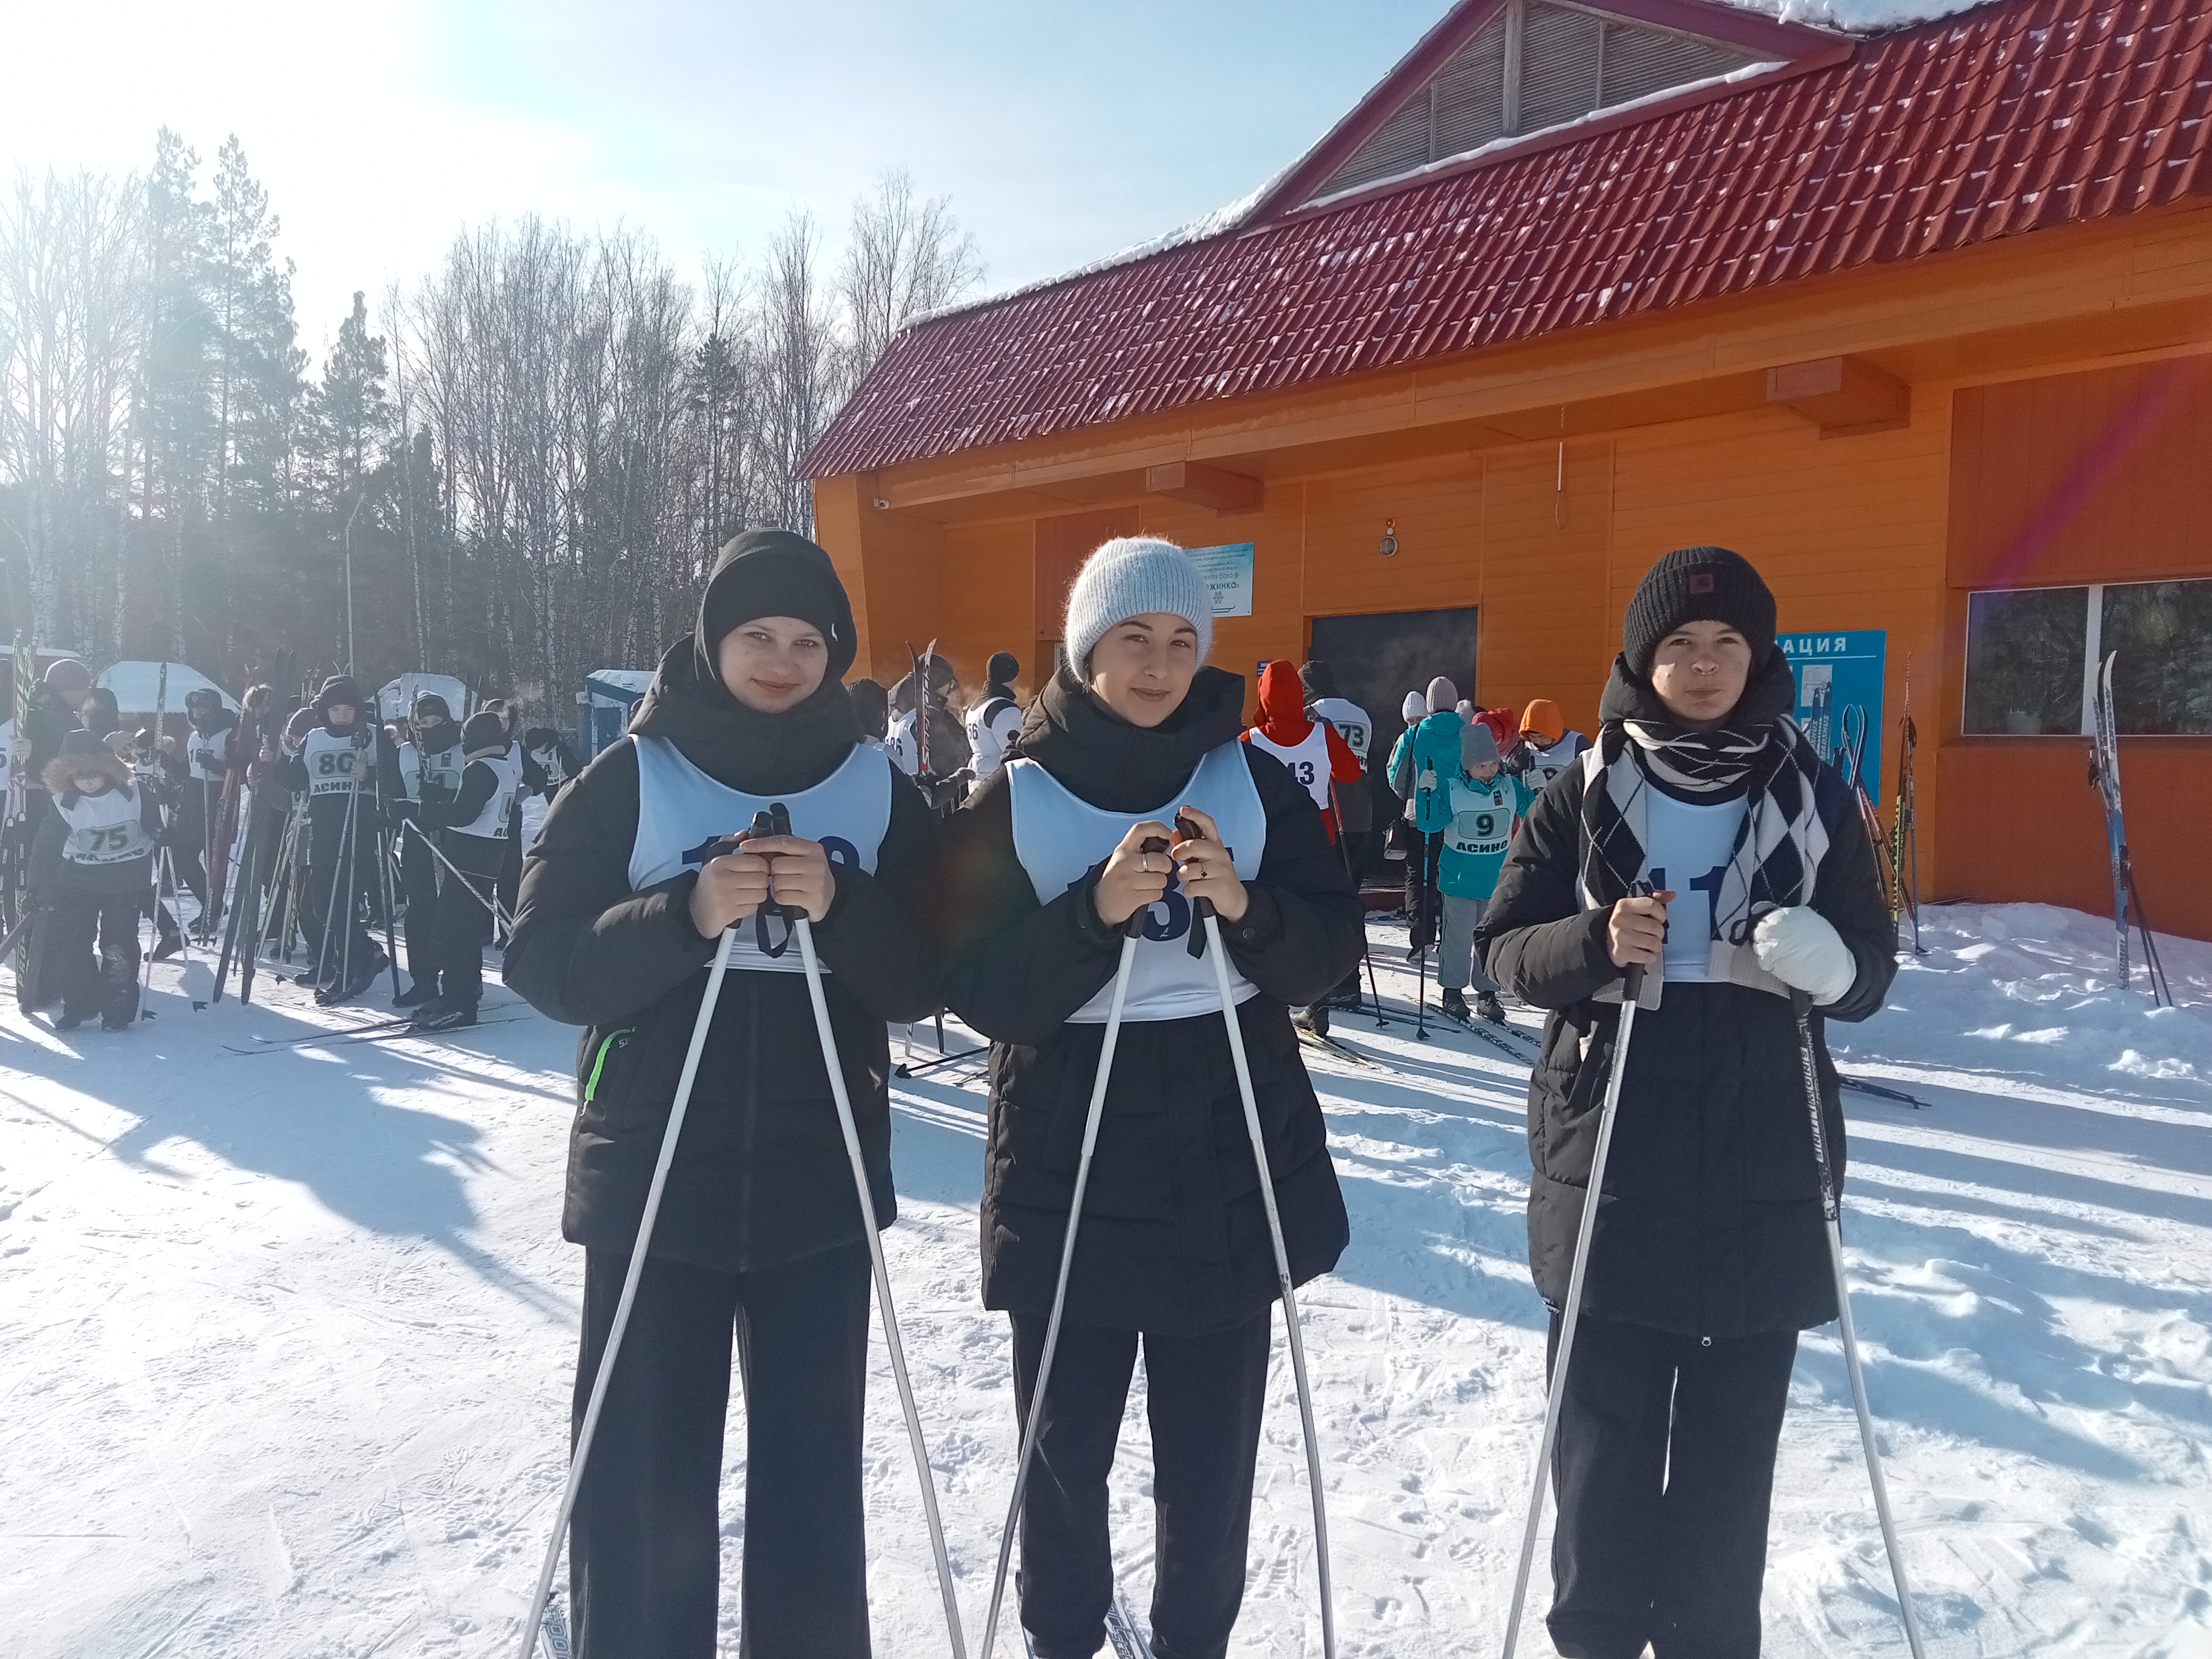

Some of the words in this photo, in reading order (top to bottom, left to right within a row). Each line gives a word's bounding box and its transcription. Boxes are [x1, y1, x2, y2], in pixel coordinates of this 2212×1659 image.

[1207, 582, 1239, 591] жинка»
[1338, 724, 1364, 748] 73
[1820, 714, 1829, 761] MADSHUS
[319, 752, 356, 775] 80
[314, 782, 353, 793] АСИН
[1476, 814, 1494, 836] 9
[89, 825, 129, 851] 75
[1456, 840, 1508, 853] АСИНО
[1800, 1046, 1824, 1163] SNOWLINE
